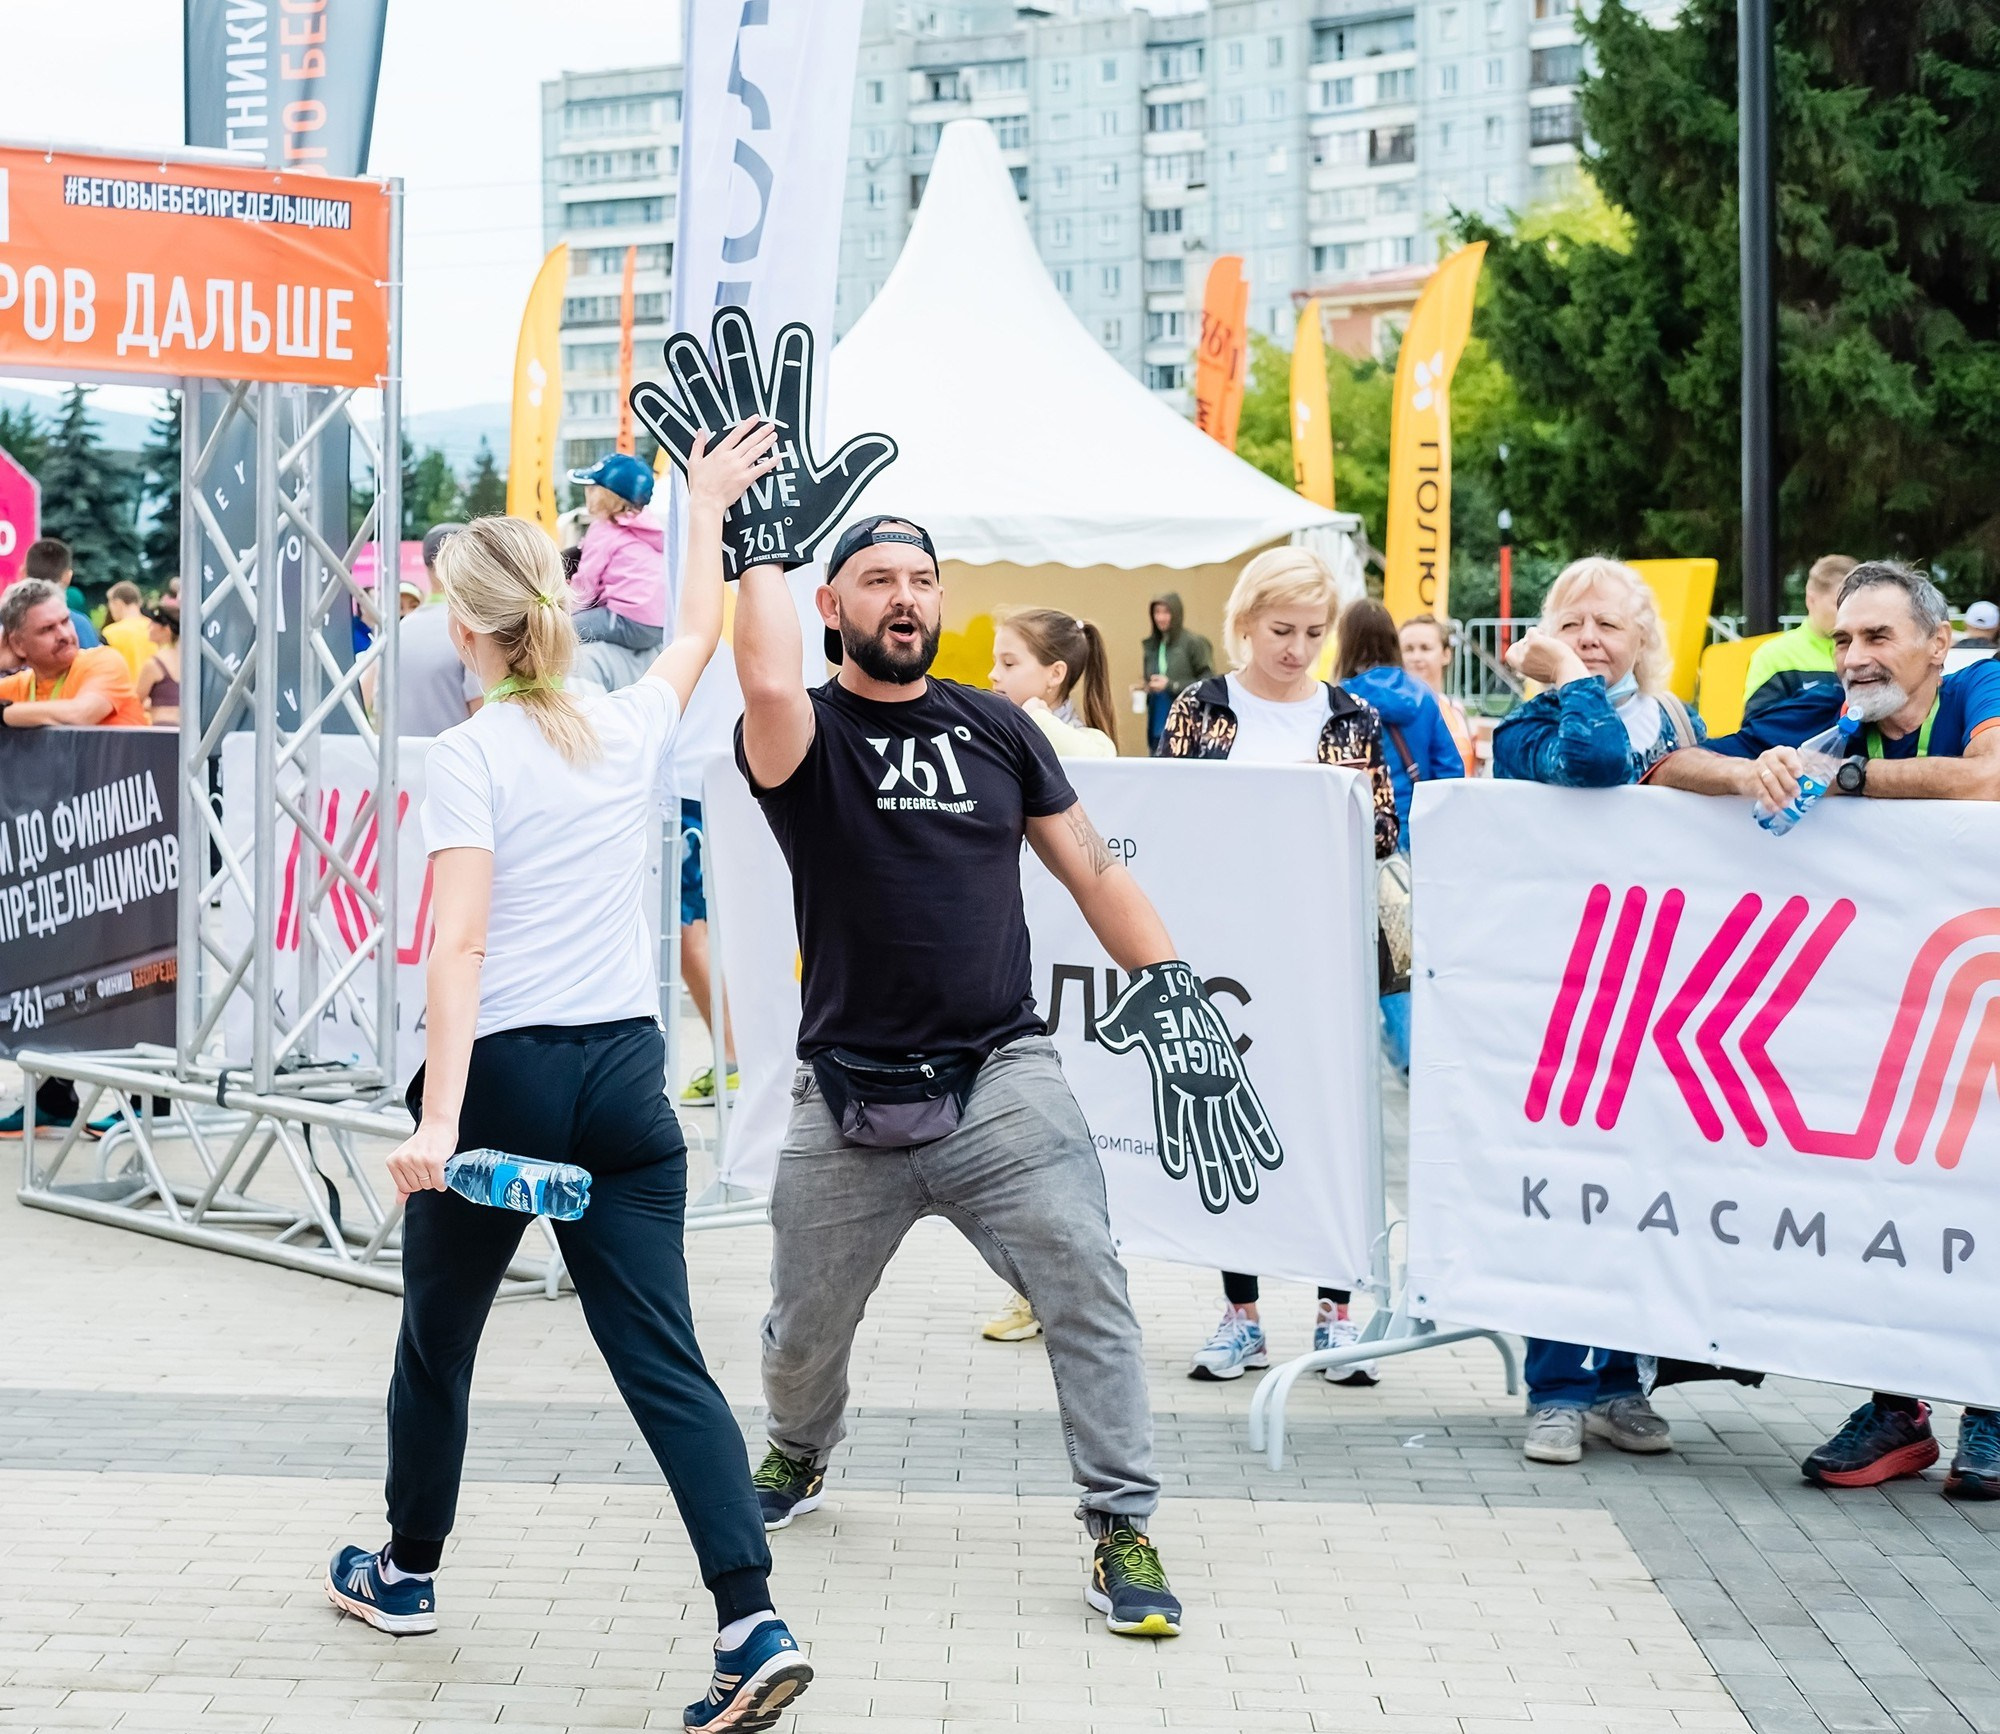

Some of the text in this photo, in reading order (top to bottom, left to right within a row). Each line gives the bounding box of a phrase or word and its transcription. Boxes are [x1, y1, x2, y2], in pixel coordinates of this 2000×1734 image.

[64, 175, 351, 230] #БЕГОВЫЕБЕСПРЕДЕЛЬЩИКИ
[116, 272, 354, 361] ДАЛЬШЕ
[724, 472, 801, 523] IVE
[15, 809, 48, 877] ДО
[52, 770, 163, 854] ФИНИША
[877, 798, 897, 810] ONE
[899, 798, 938, 810] DEGREE
[96, 970, 133, 999] ФИНИШ
[1158, 1040, 1236, 1079] HIGH
[1522, 1175, 1976, 1275] КРАСМАР
